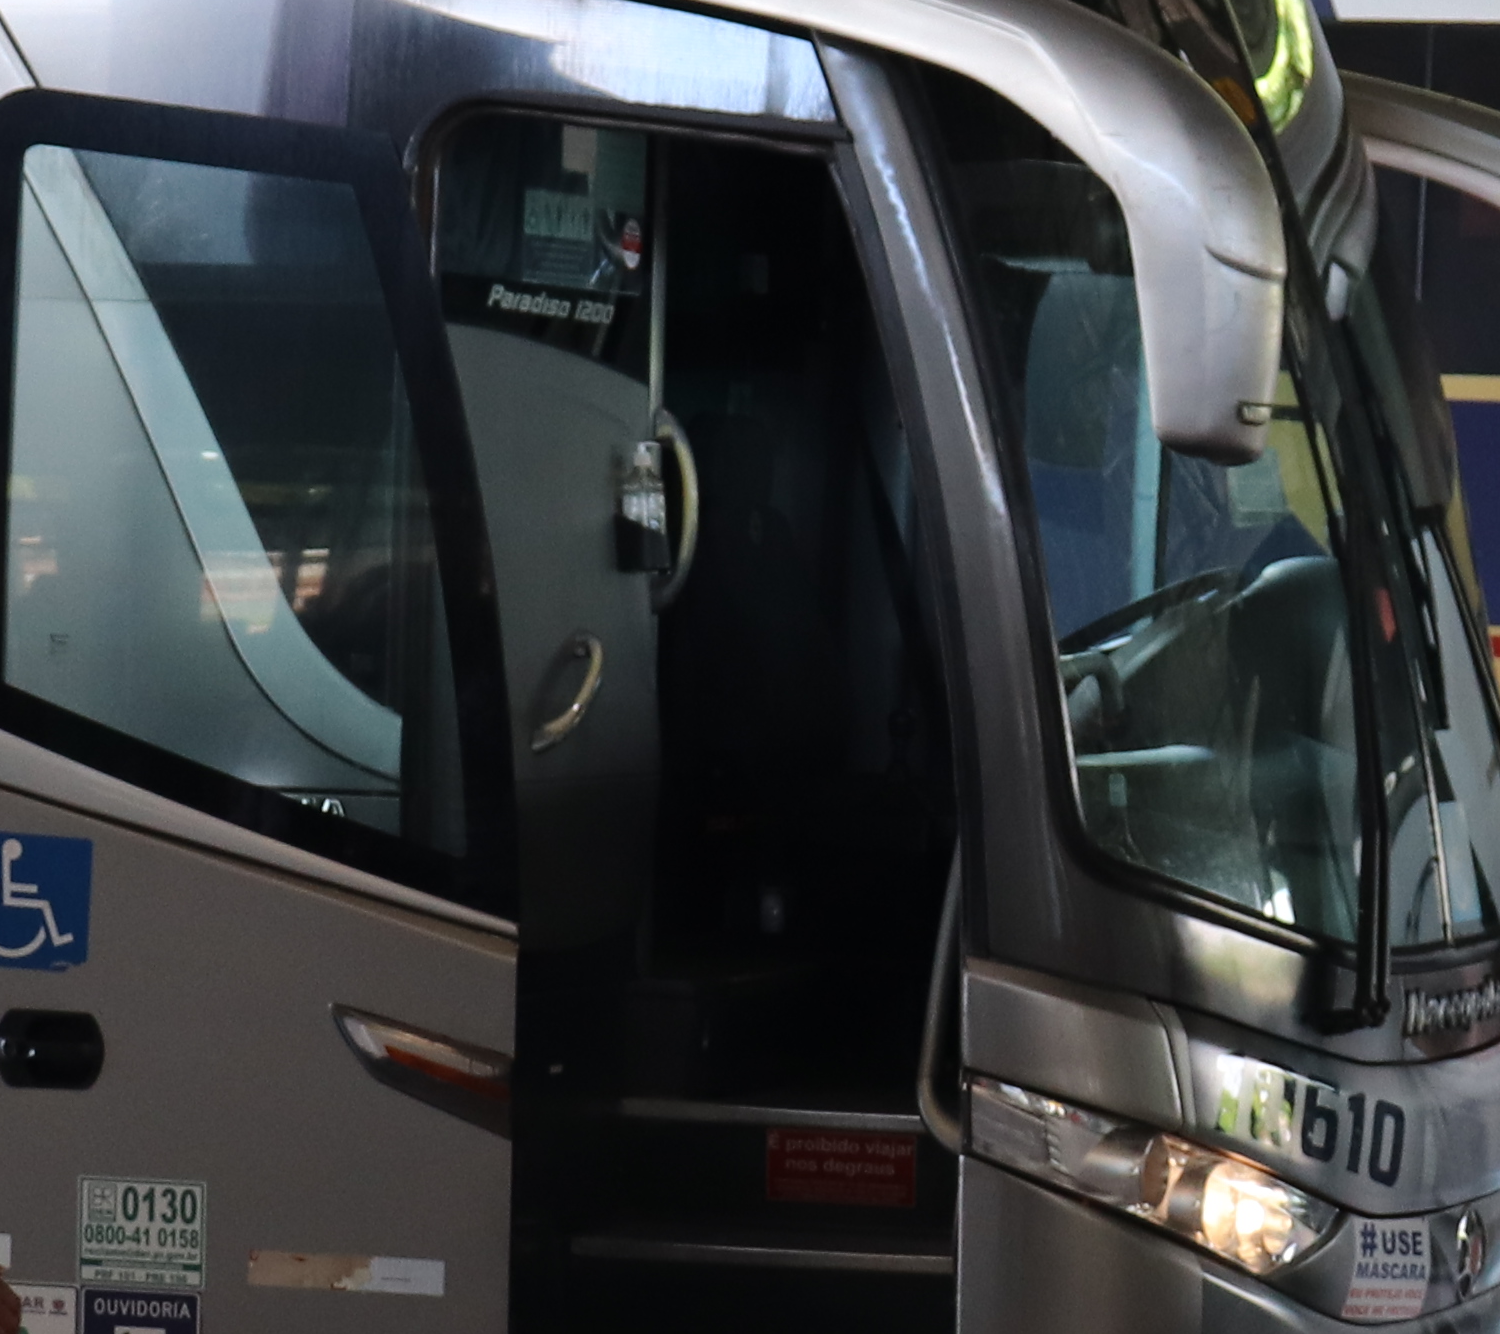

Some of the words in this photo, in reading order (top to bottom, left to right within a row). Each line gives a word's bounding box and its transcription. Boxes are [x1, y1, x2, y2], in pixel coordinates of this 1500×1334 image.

[488, 284, 571, 317] Paradiso
[785, 1137, 860, 1154] proibido
[864, 1140, 915, 1159] viajar
[785, 1158, 818, 1172] nos
[823, 1158, 895, 1177] degraus
[122, 1186, 197, 1224] 0130
[84, 1224, 150, 1245] 0800-41
[158, 1227, 199, 1249] 0158
[94, 1298, 192, 1319] OUVIDORIA
